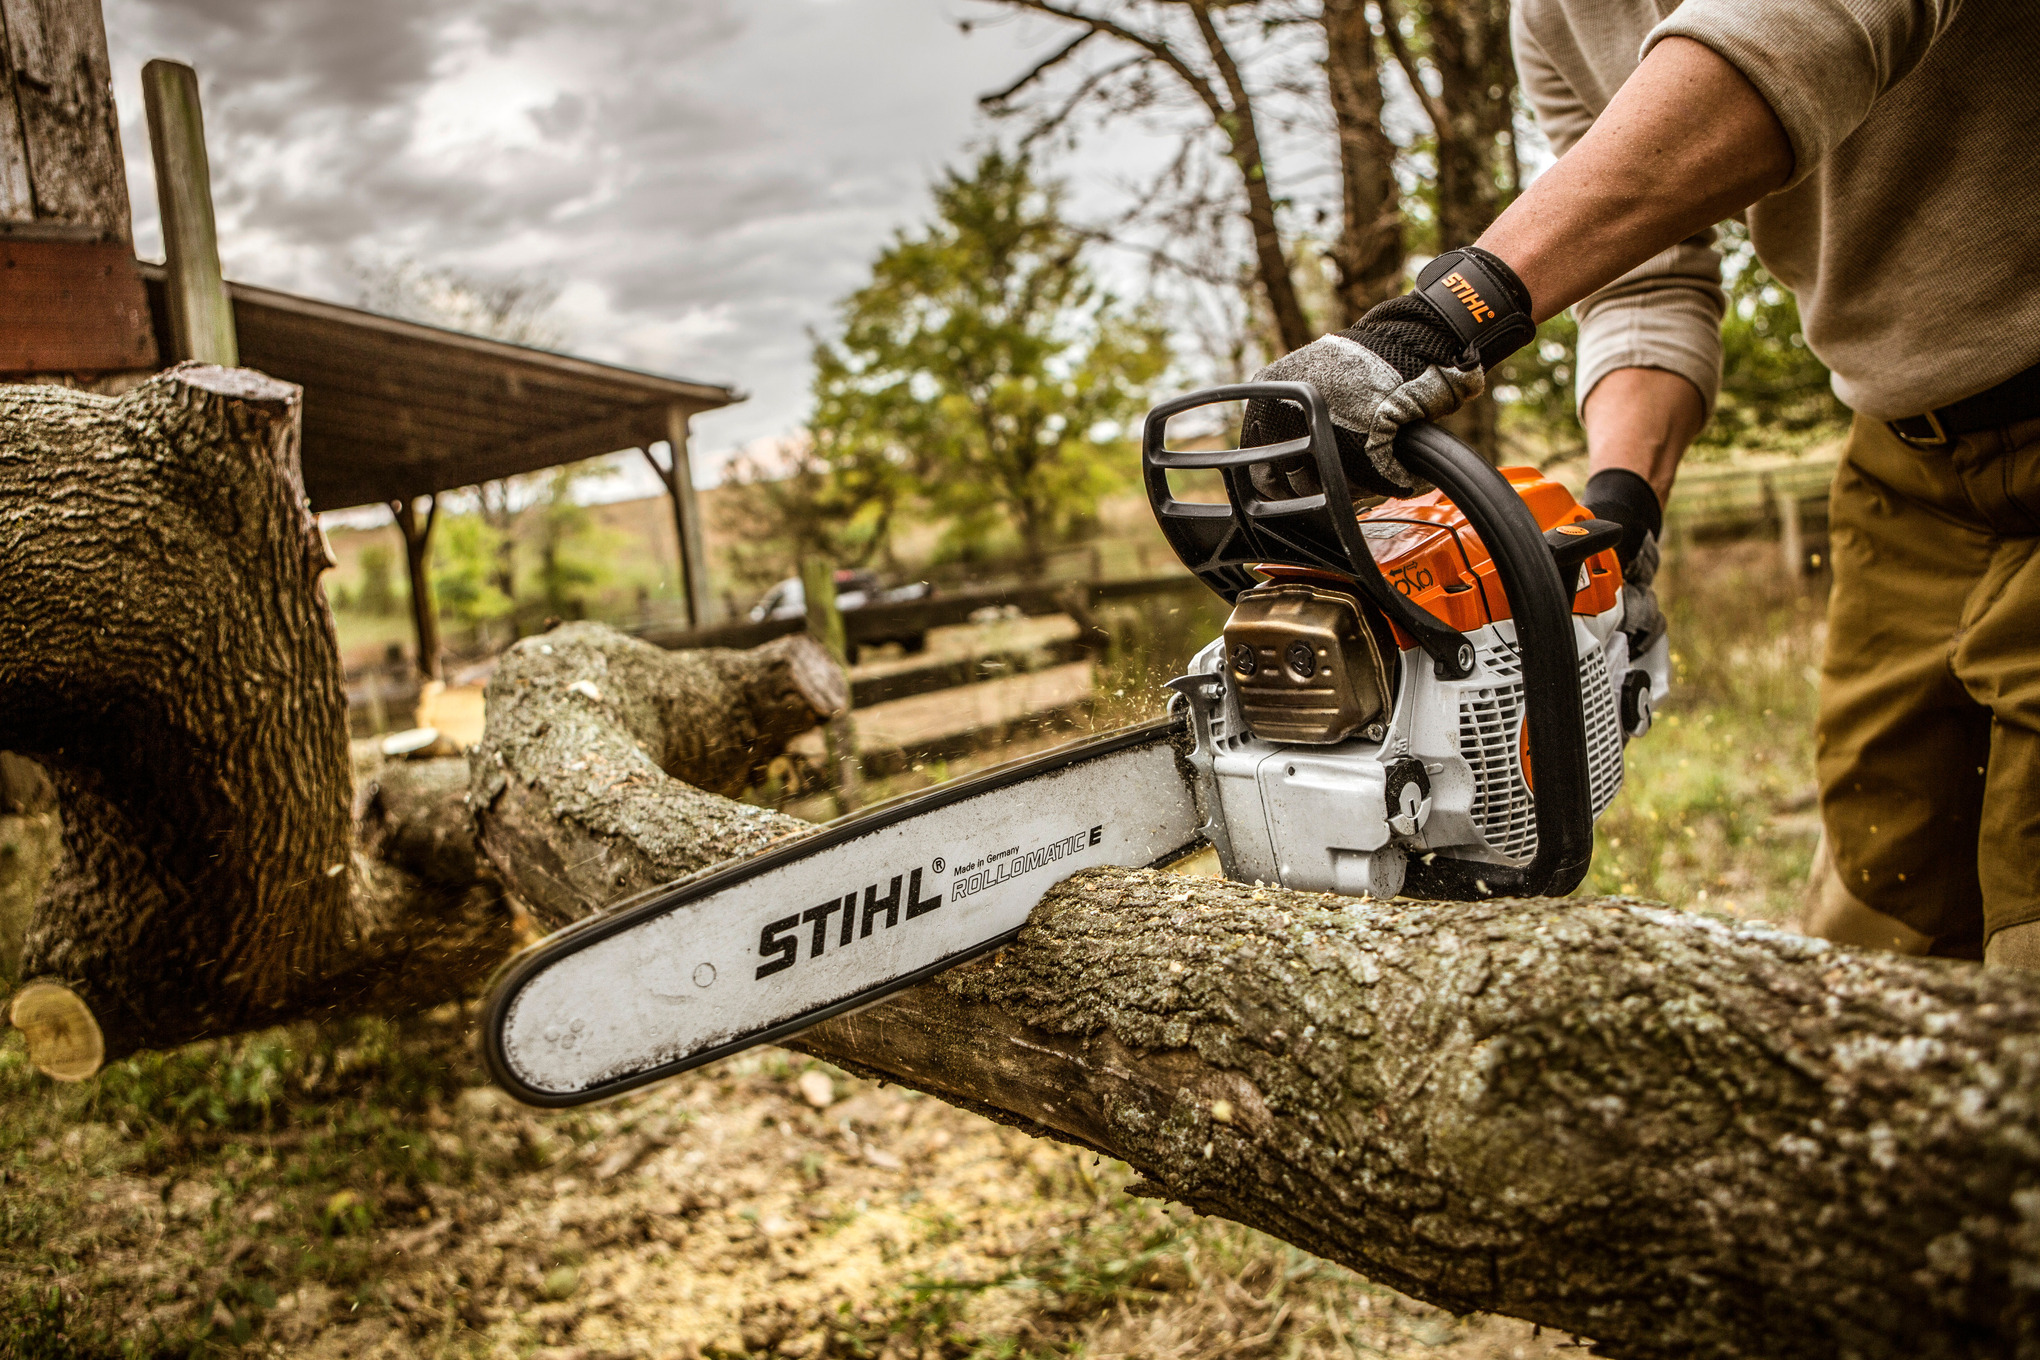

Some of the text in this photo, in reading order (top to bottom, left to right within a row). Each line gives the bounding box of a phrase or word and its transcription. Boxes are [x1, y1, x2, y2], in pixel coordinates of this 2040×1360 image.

[951, 824, 1103, 903] ROLLOMATIC E
[953, 845, 1020, 876] Made in Germany
